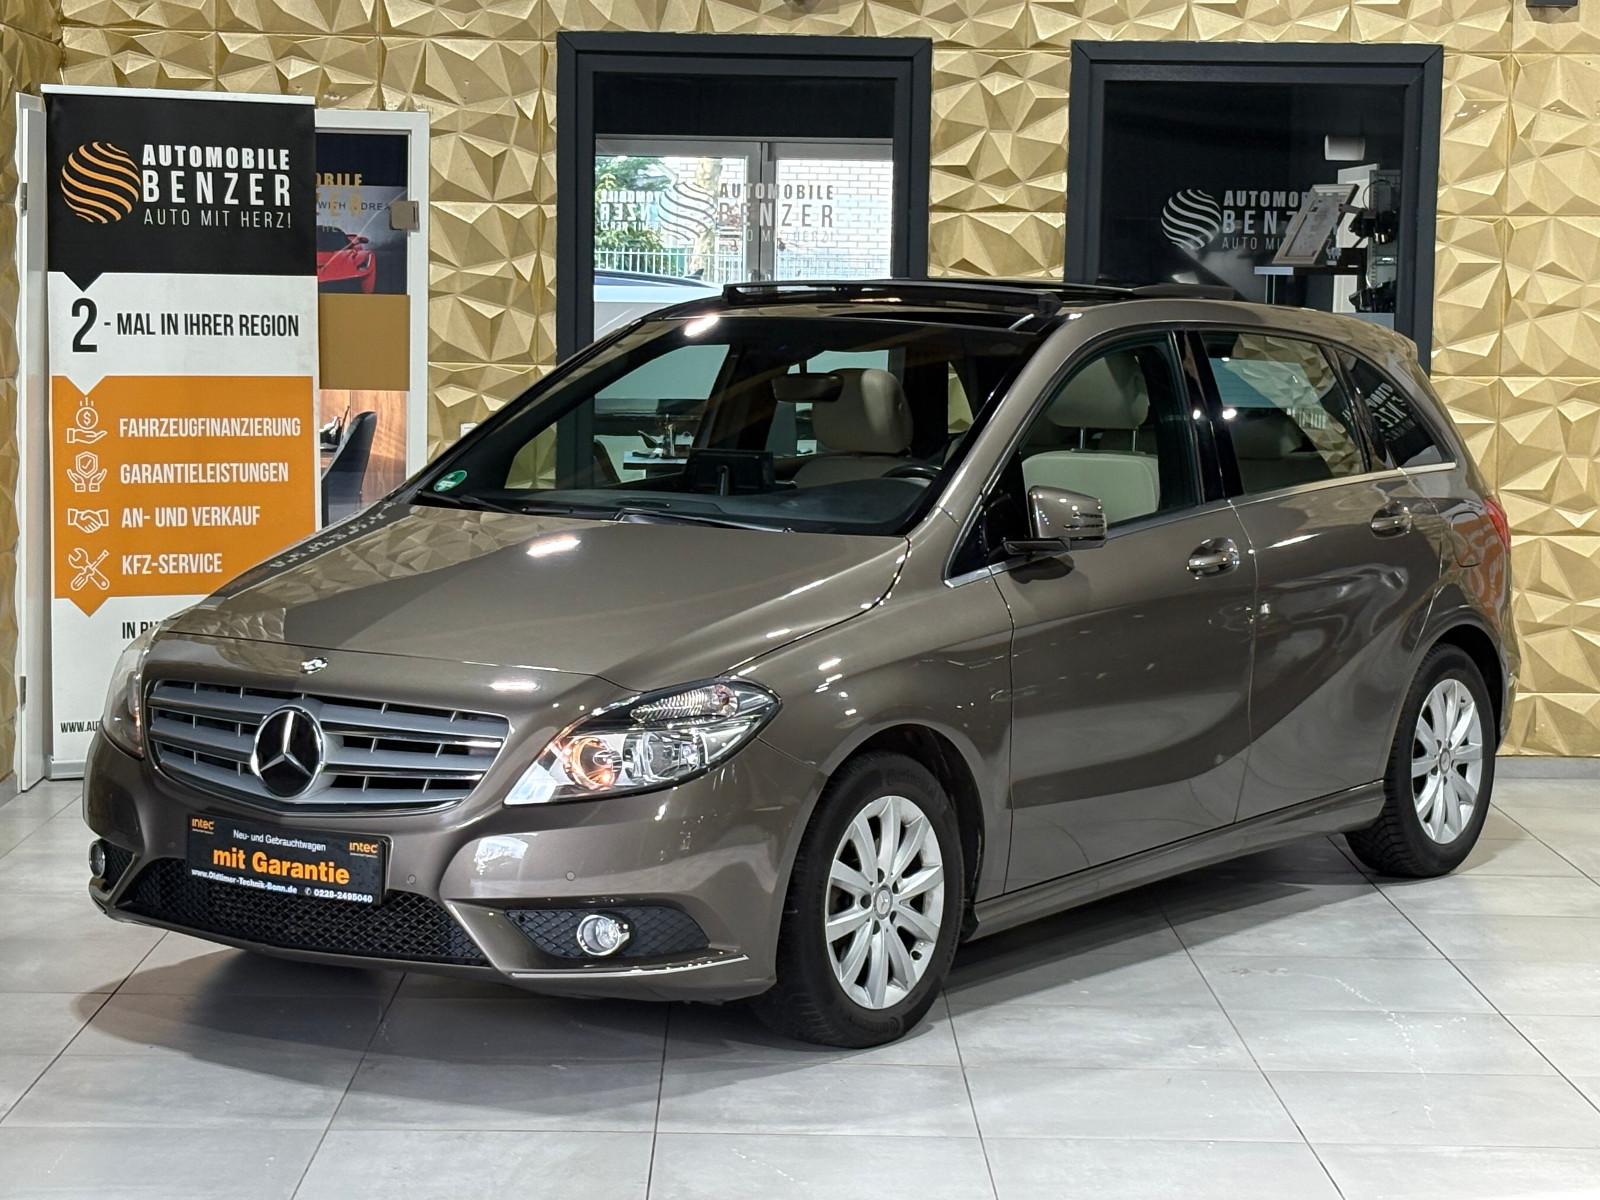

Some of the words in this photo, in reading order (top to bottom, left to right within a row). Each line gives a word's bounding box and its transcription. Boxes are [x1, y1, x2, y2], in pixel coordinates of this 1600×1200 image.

[142, 144, 290, 171] AUTOMOBILE
[142, 169, 290, 206] BENZER
[720, 183, 834, 200] AUTOMOBILE
[143, 208, 190, 225] AUTO
[200, 210, 231, 227] MIT
[240, 211, 291, 229] HERZ!
[720, 202, 833, 228] BENZER
[1221, 237, 1258, 250] AUTO
[71, 297, 98, 353] 2
[116, 313, 156, 336] MAL
[160, 313, 179, 336] IN
[184, 313, 234, 337] IHRER
[239, 314, 299, 337] REGION
[119, 417, 301, 438] FAHRZEUGFINANZIERUNG
[120, 462, 289, 484] GARANTIELEISTUNGEN
[121, 507, 151, 528] AN-
[155, 506, 188, 528] UND
[191, 505, 261, 527] VERKAUF
[122, 553, 223, 575] KFZ-SERVICE
[122, 621, 136, 639] IN
[191, 817, 215, 830] intec
[233, 829, 250, 840] Neu-
[251, 834, 264, 843] und
[265, 834, 327, 852] Gebrauchtwagen
[349, 841, 378, 854] intec
[213, 847, 246, 869] mit
[252, 851, 350, 885] Garantie
